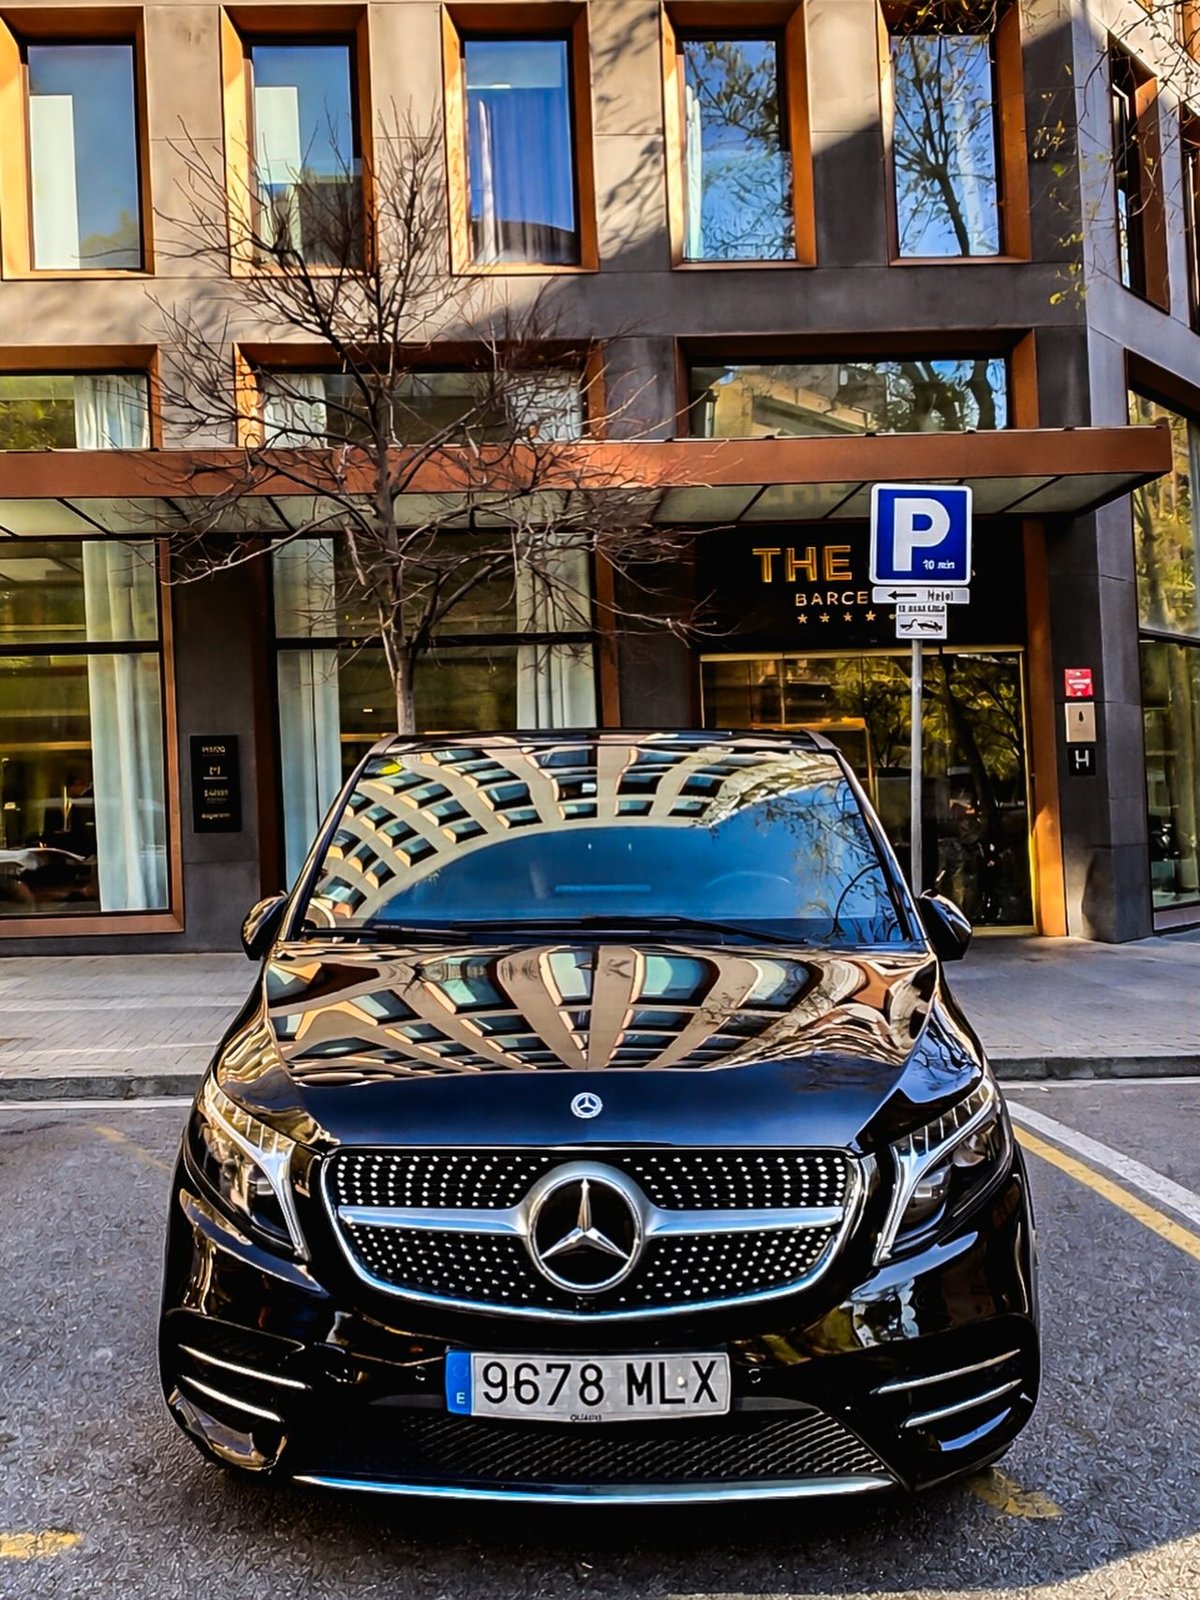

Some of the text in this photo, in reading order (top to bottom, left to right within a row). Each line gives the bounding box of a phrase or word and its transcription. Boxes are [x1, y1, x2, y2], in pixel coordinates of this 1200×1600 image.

[893, 497, 951, 572] P
[752, 545, 853, 583] THE
[937, 559, 956, 569] min
[456, 1392, 466, 1404] E
[482, 1360, 718, 1407] 9678 MLX
